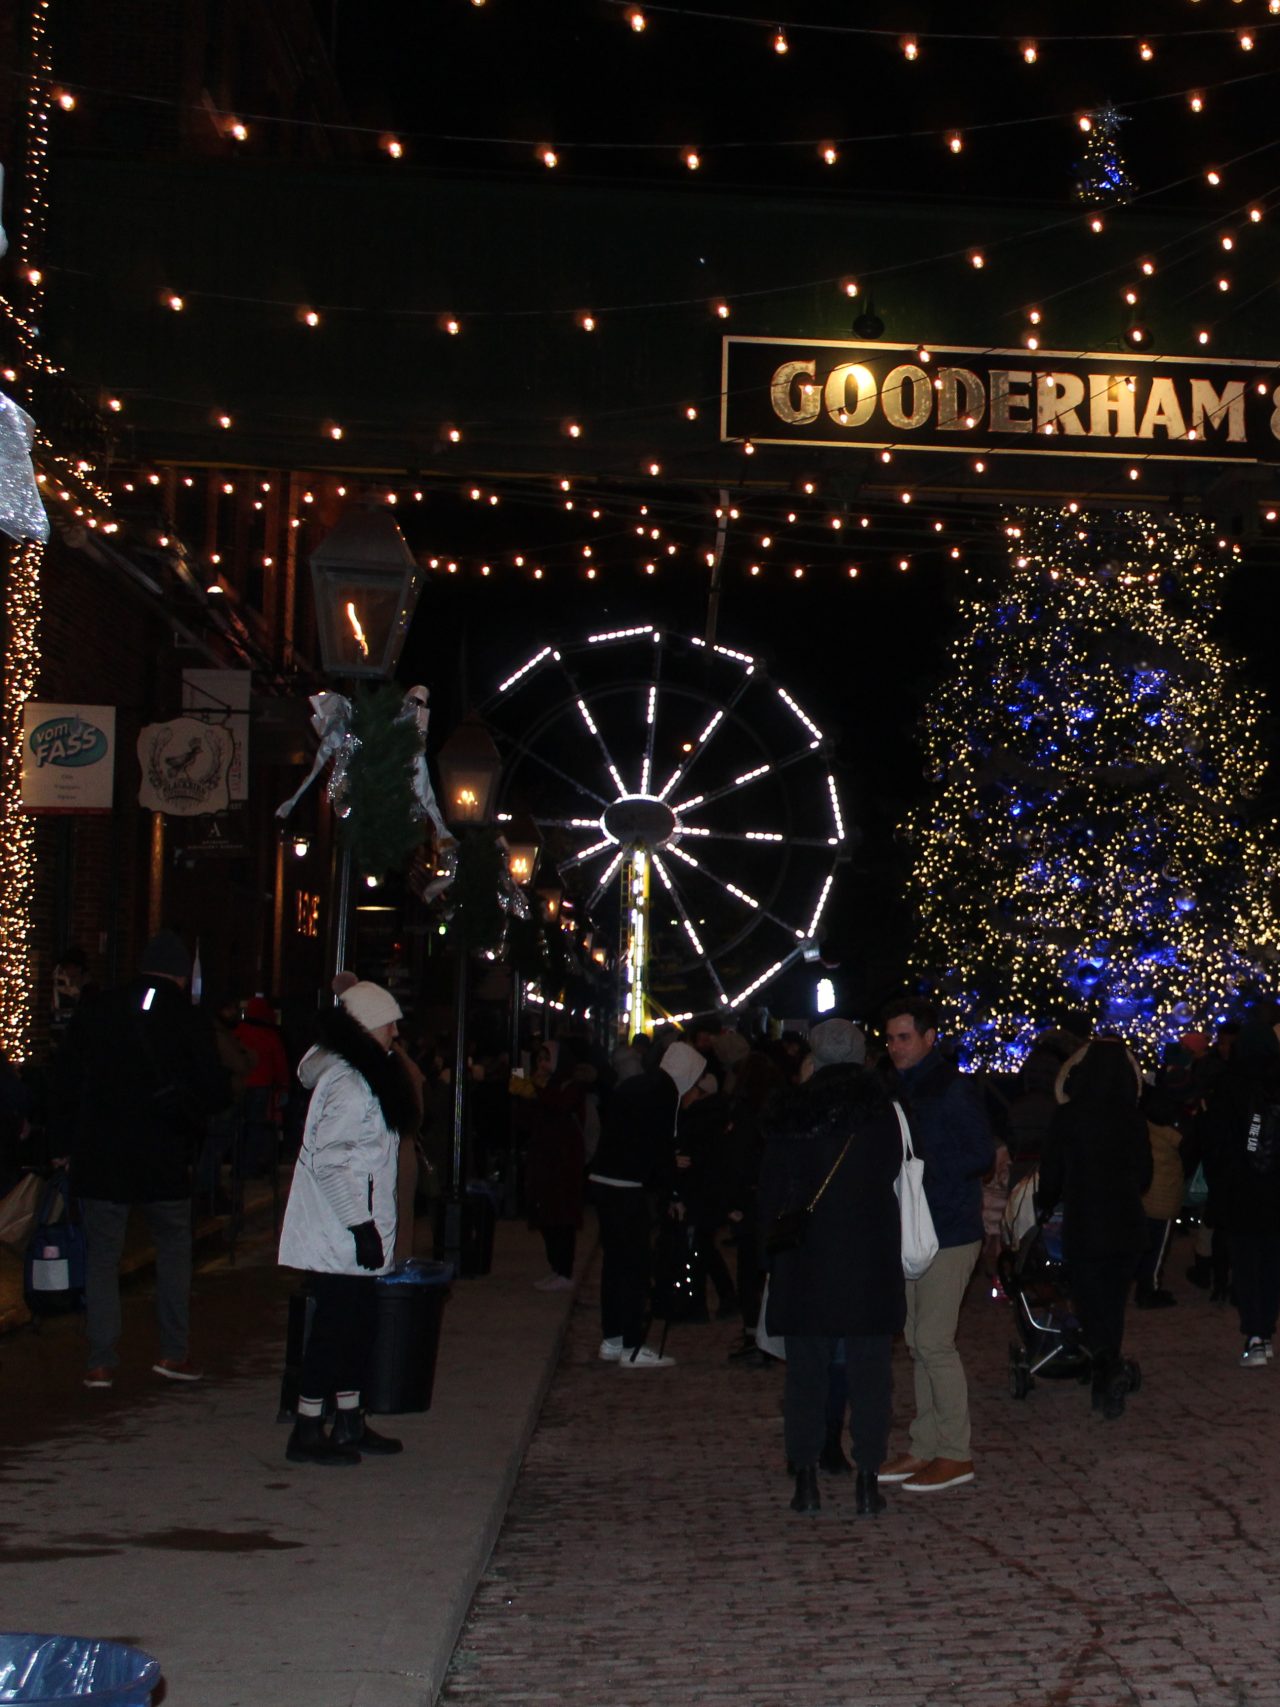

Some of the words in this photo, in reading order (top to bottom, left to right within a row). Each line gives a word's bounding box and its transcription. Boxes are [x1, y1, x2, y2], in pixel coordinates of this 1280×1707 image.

[771, 359, 1247, 443] GOODERHAM
[35, 727, 97, 768] FASS
[36, 723, 68, 743] vom
